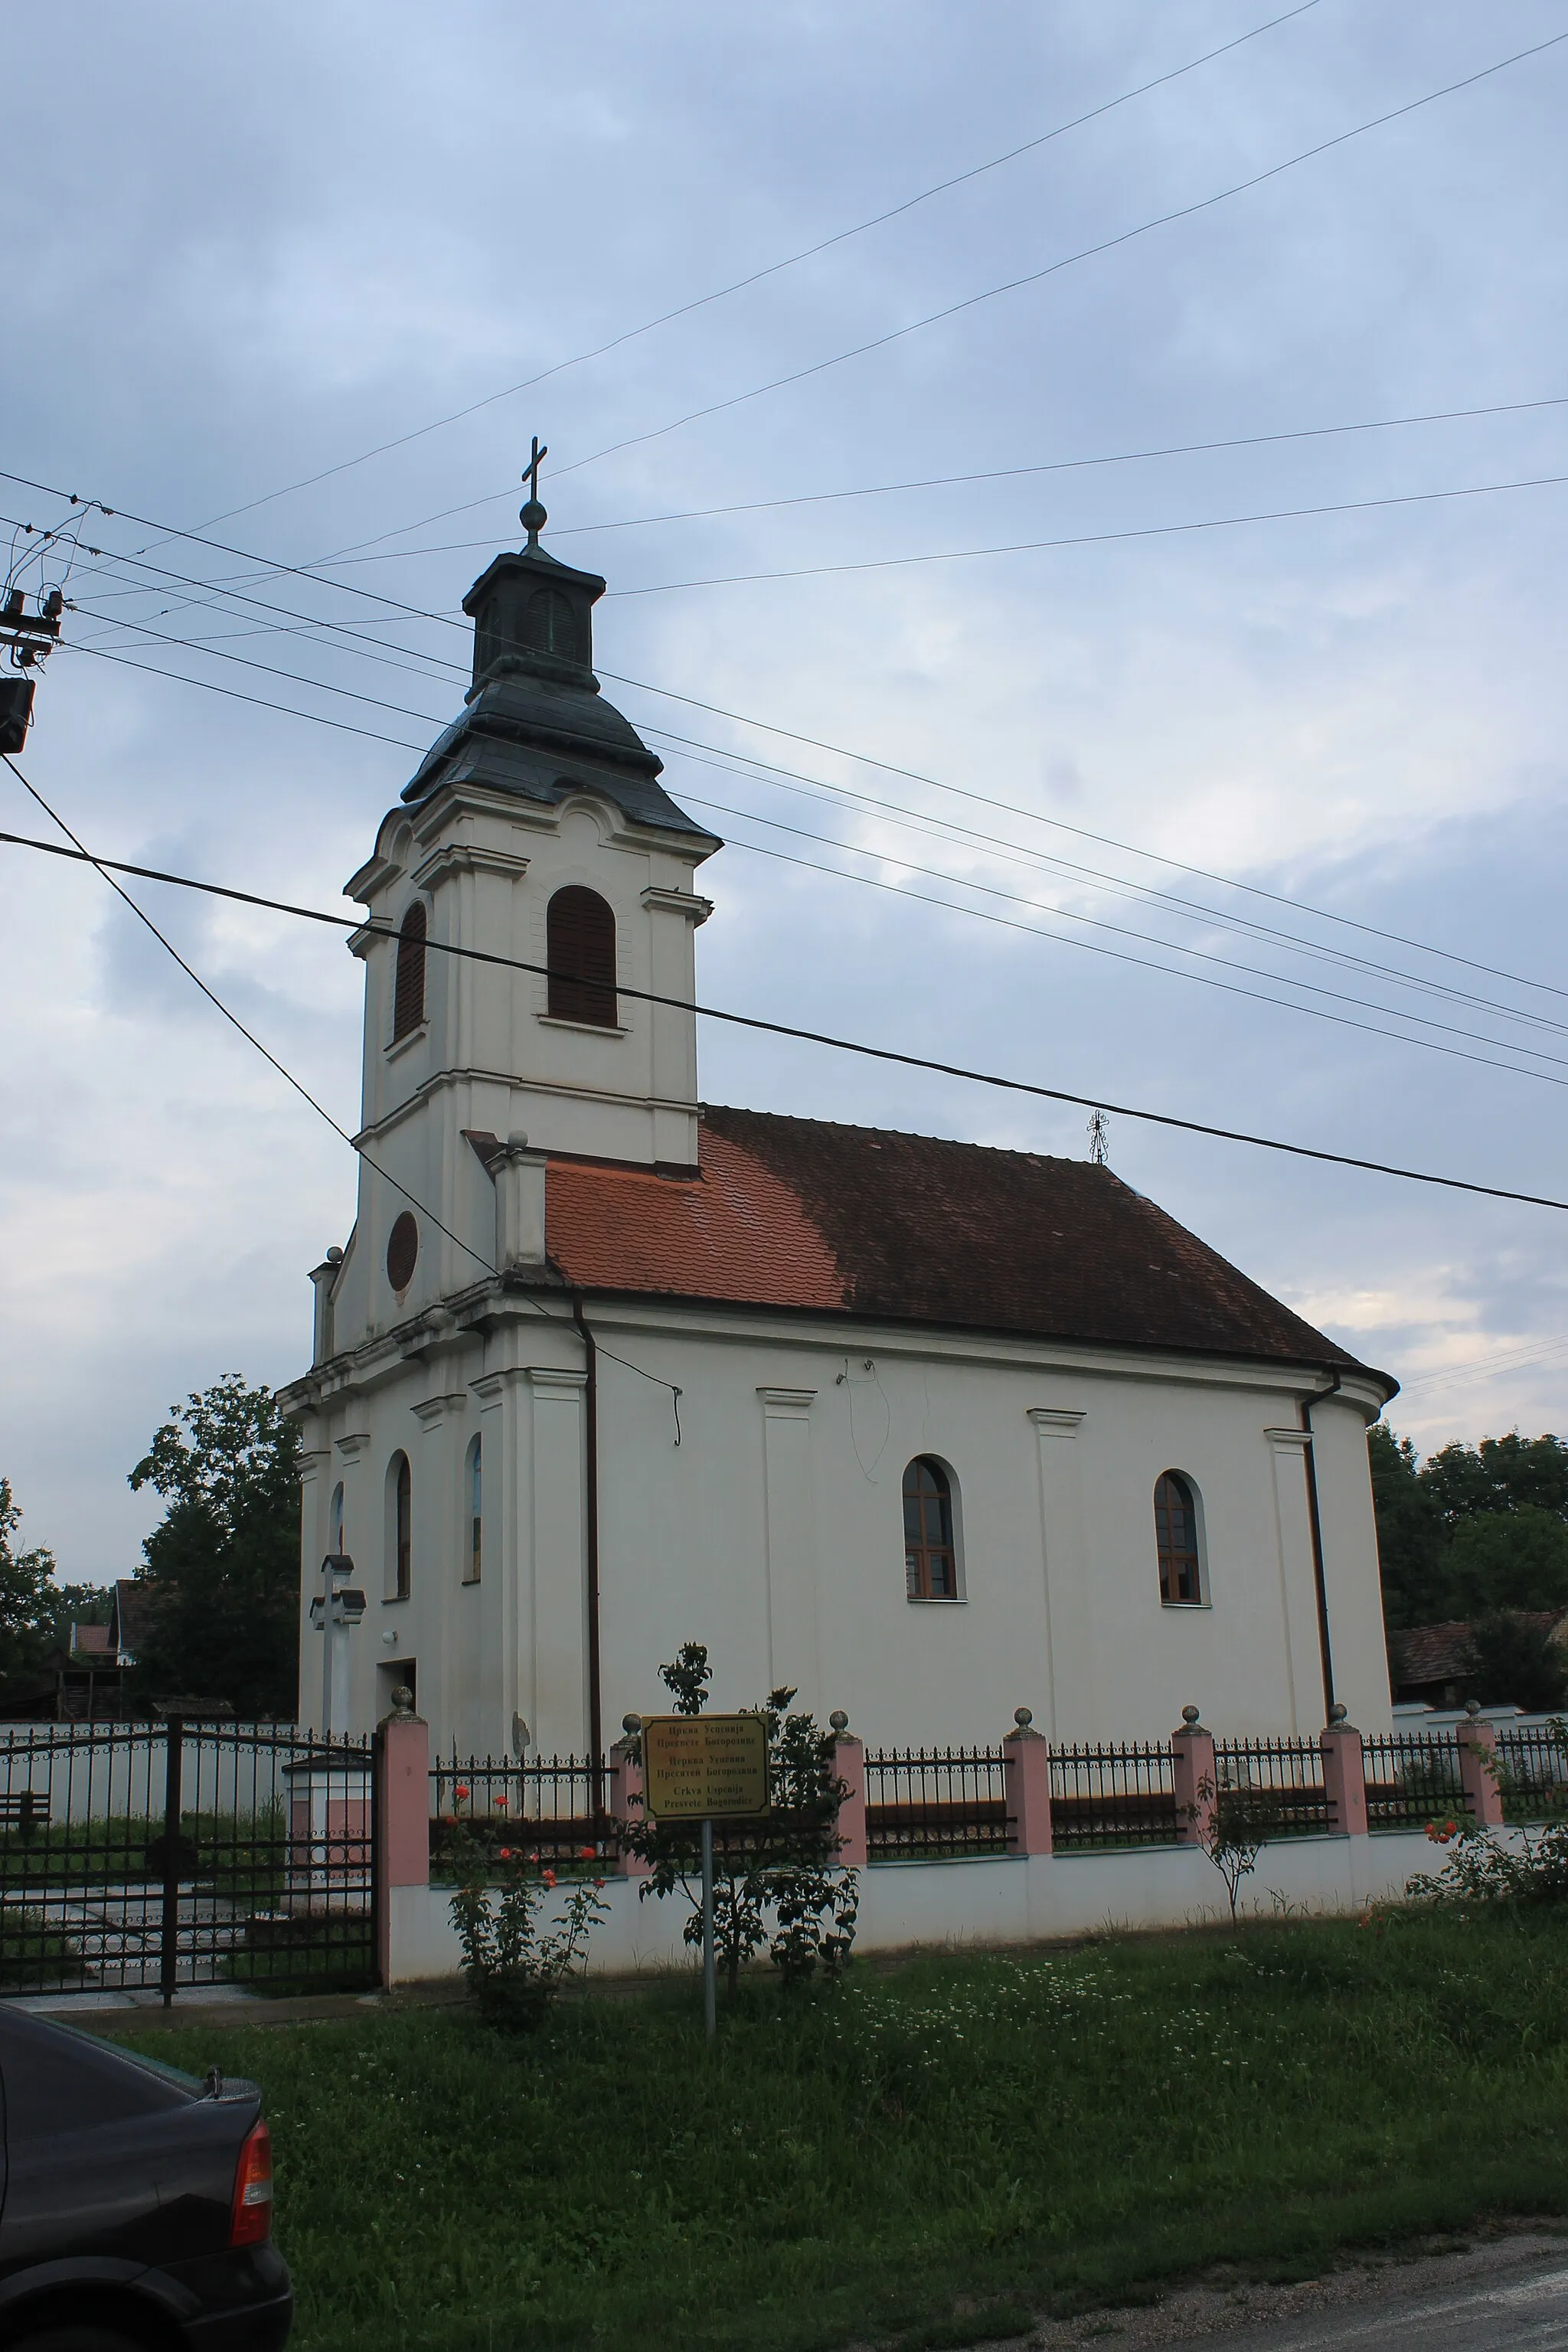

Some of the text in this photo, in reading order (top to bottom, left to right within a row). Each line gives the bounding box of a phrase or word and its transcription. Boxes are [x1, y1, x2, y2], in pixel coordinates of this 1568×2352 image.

[674, 1785, 743, 1795] Crkva Uspenija
[665, 1798, 753, 1808] Presvete Bogorodice
